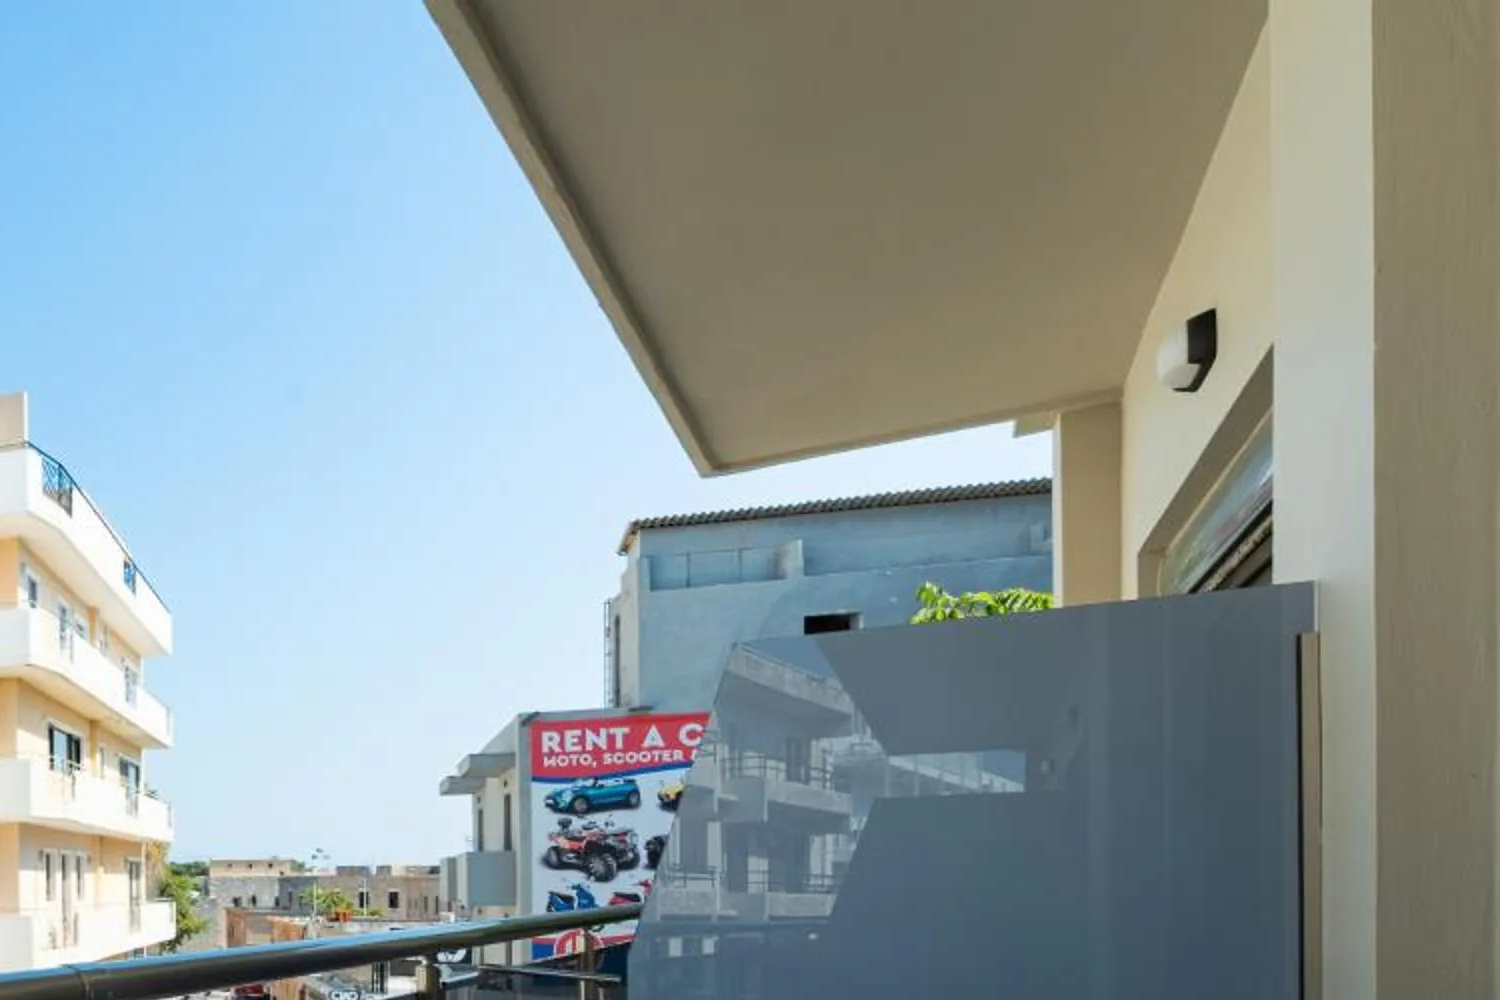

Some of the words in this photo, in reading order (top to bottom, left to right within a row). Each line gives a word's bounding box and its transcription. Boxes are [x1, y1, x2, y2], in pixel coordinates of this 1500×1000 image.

[541, 727, 631, 754] RENT
[642, 724, 665, 748] A
[543, 753, 598, 768] MOTO,
[603, 750, 684, 765] SCOOTER
